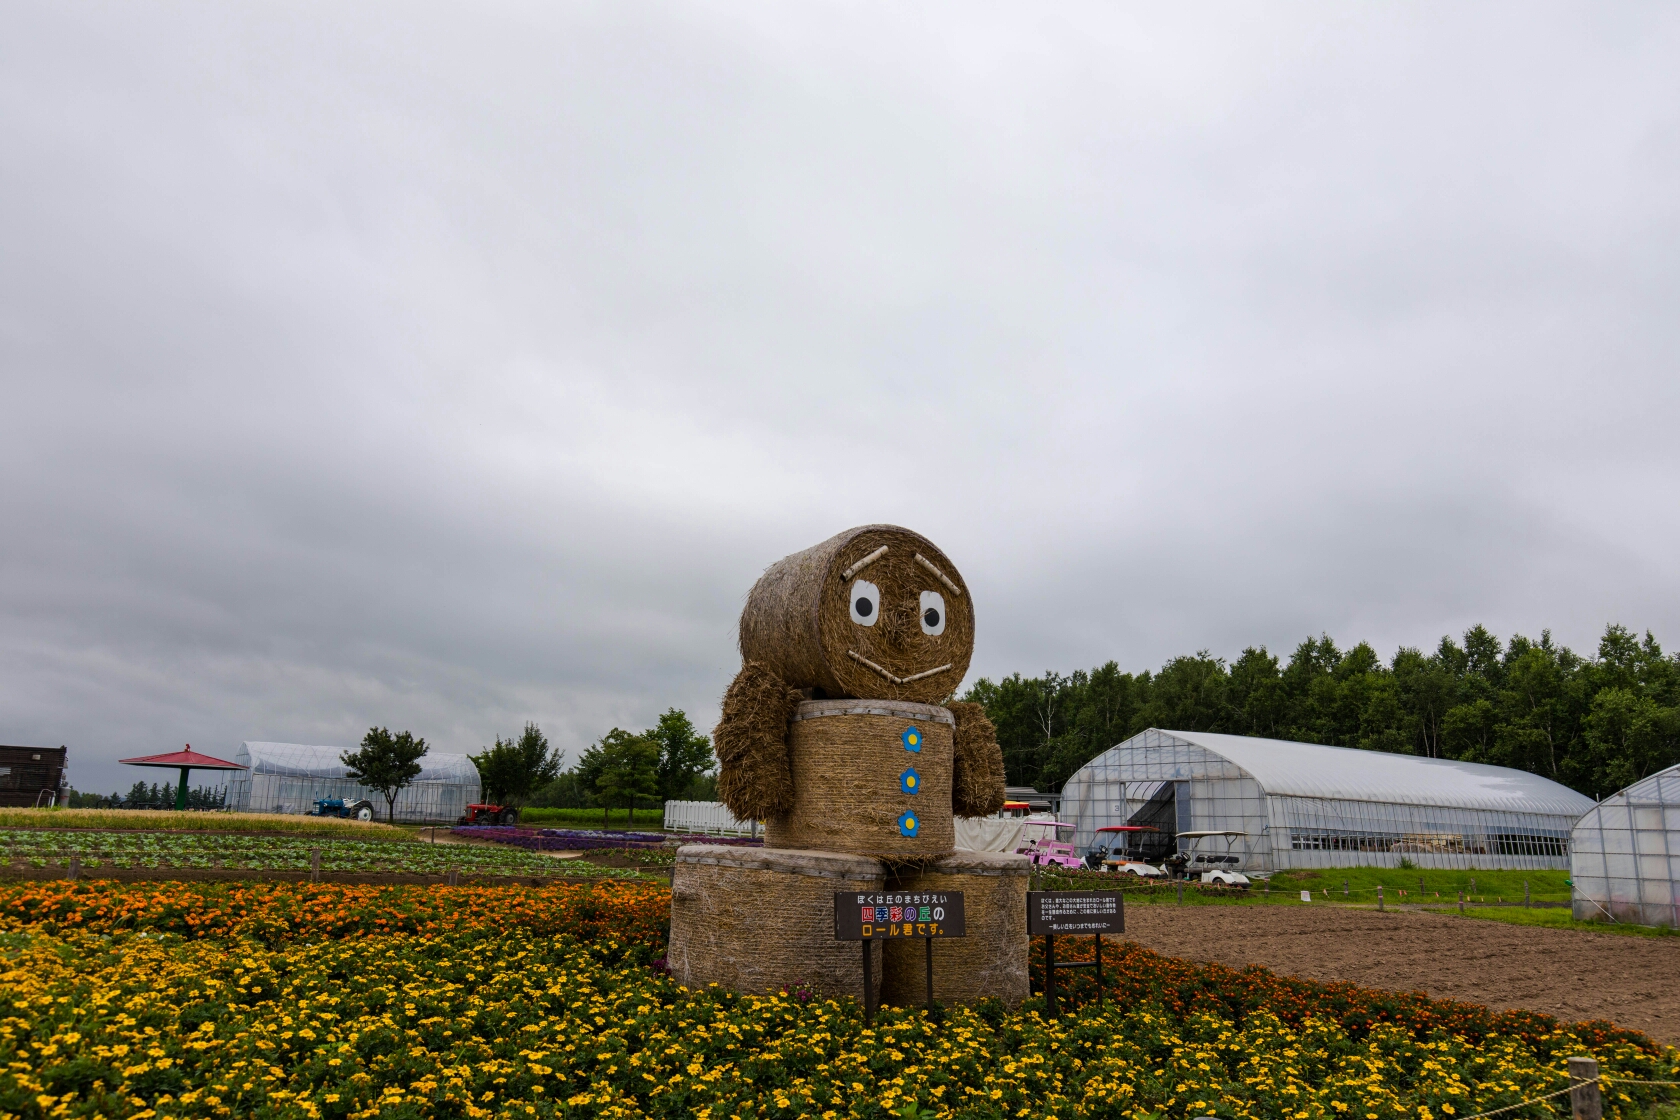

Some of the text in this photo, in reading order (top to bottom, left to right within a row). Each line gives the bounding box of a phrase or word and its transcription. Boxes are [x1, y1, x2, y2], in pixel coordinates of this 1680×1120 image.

[1114, 804, 1120, 812] 3
[857, 895, 948, 904] ぼくは丘のまちびえい
[861, 906, 945, 923] 四季彩の丘の
[862, 923, 944, 937] ロール君です。
